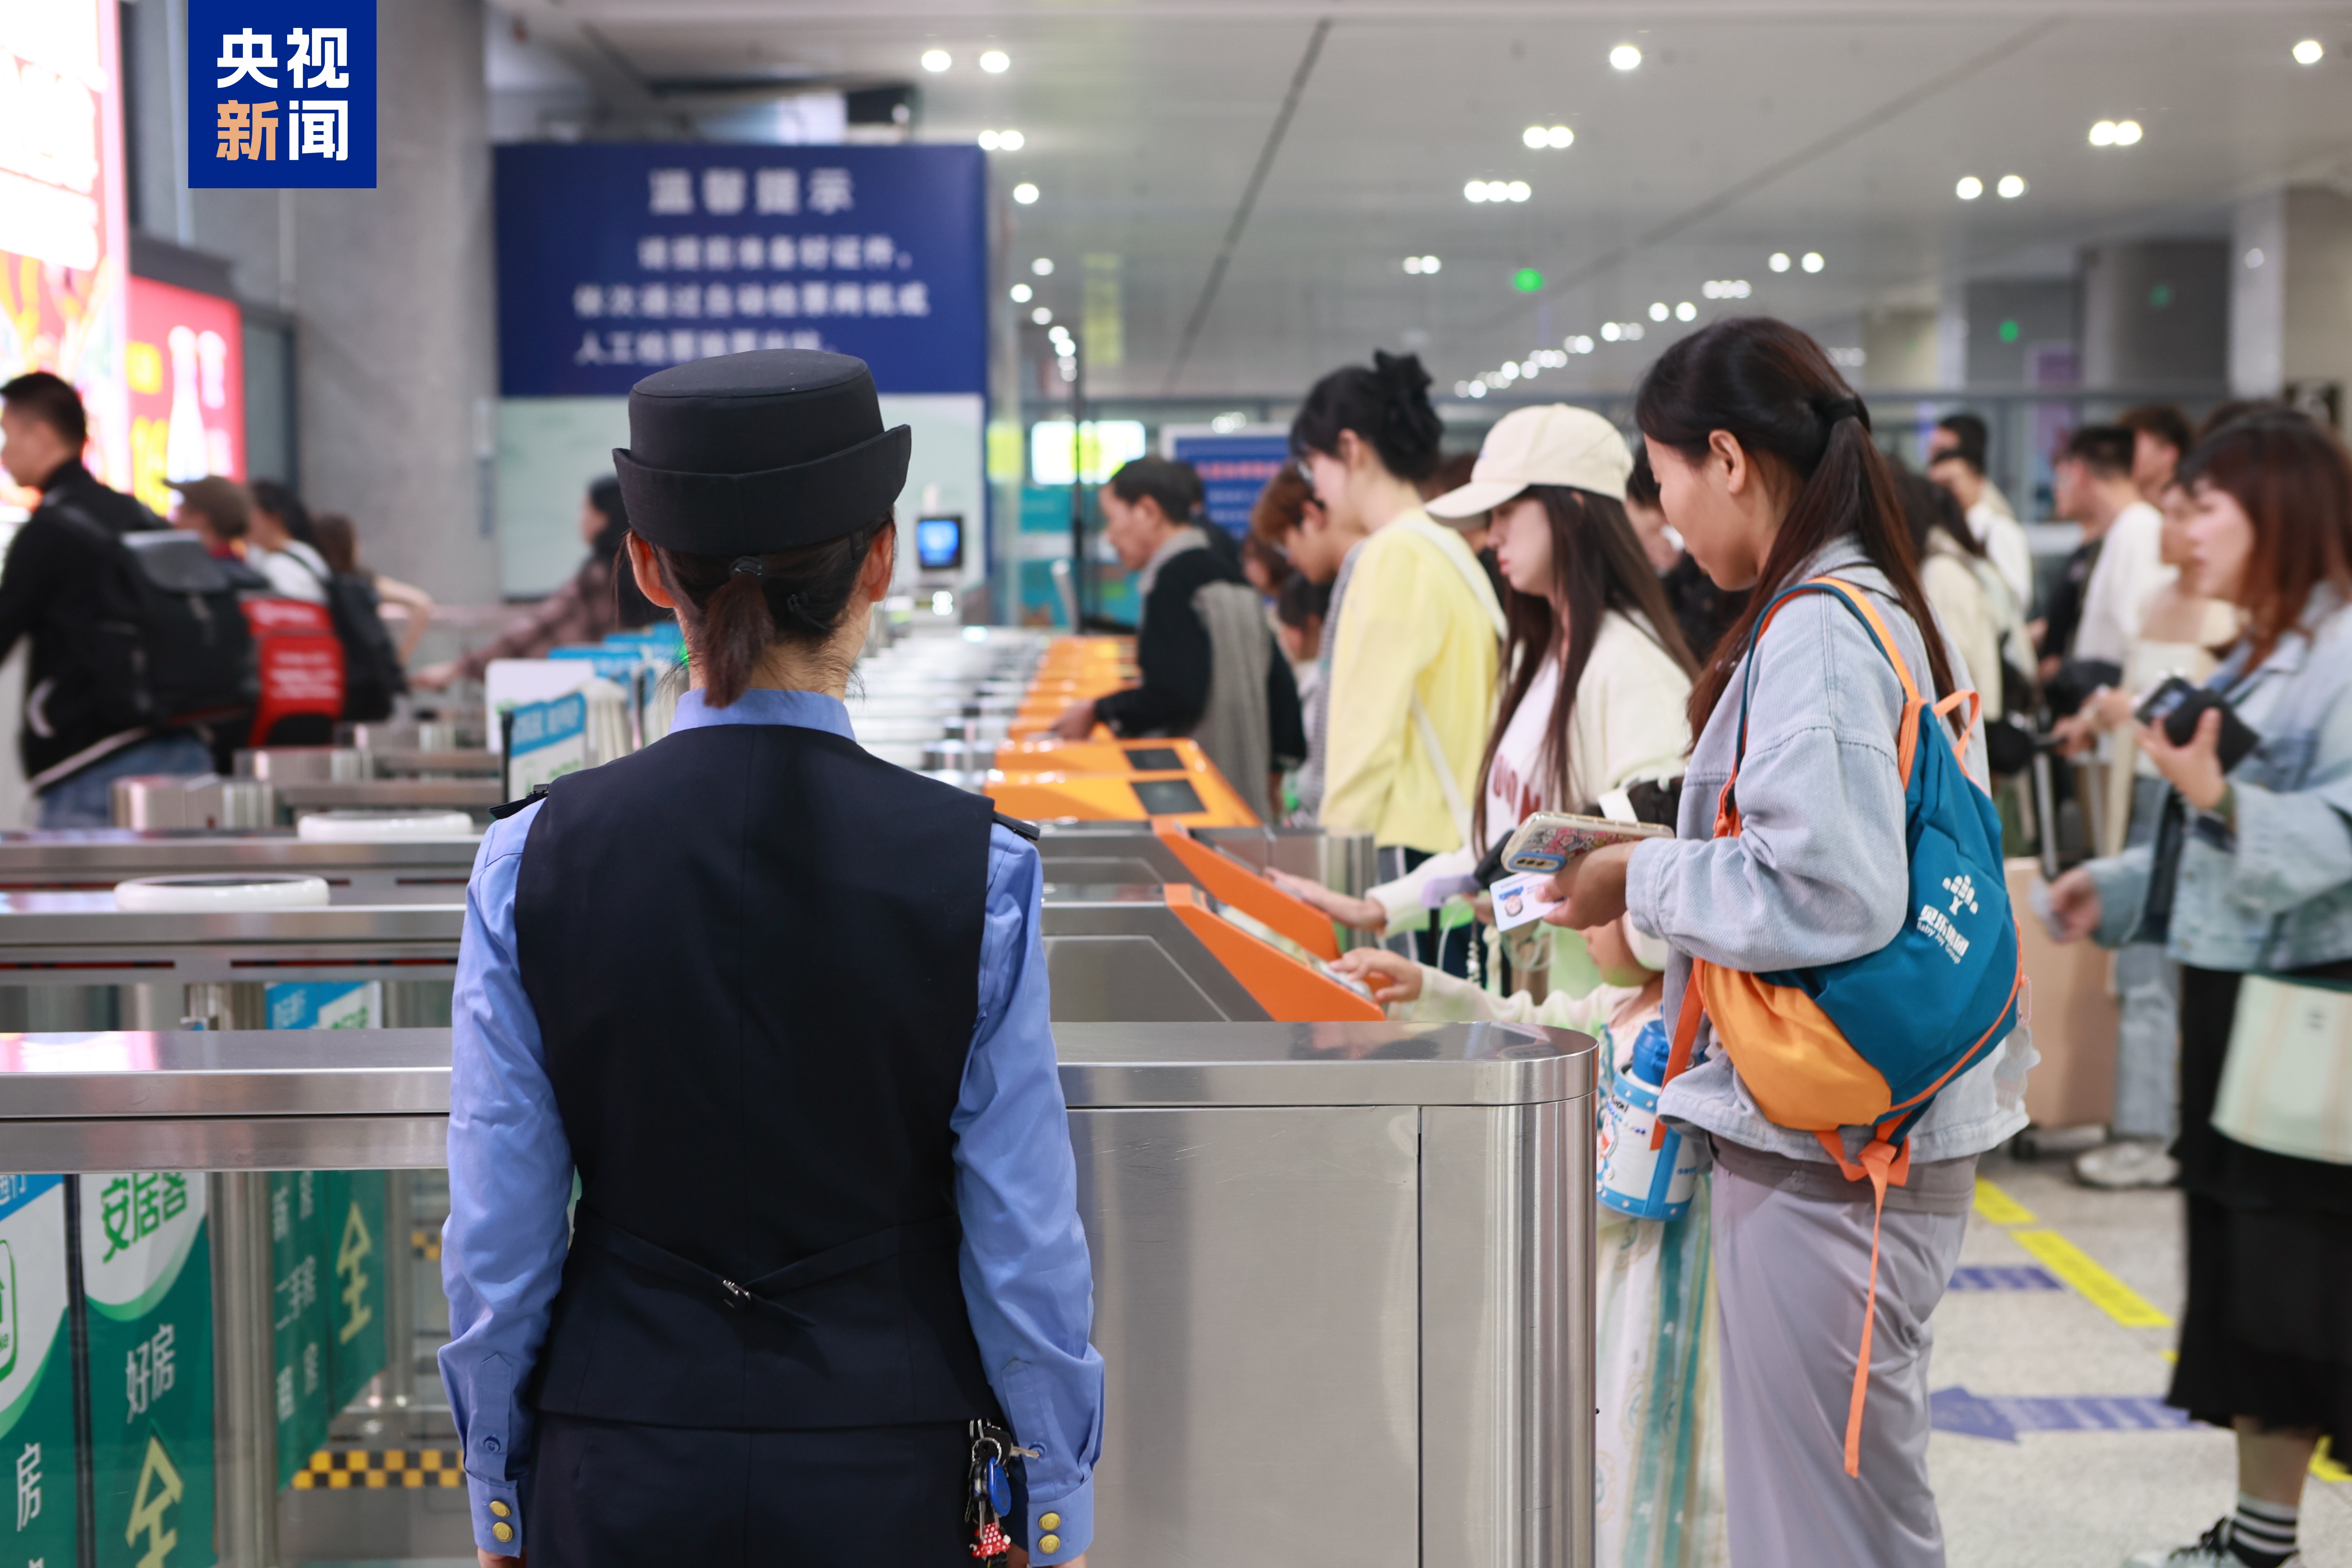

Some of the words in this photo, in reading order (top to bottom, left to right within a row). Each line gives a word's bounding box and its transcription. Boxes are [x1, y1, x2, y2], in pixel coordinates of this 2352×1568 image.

[649, 168, 853, 215] 温馨提示
[1917, 921, 1936, 937] Baby
[101, 1173, 187, 1263] 安居客
[126, 1323, 175, 1424] 好房
[16, 1442, 42, 1532] 房
